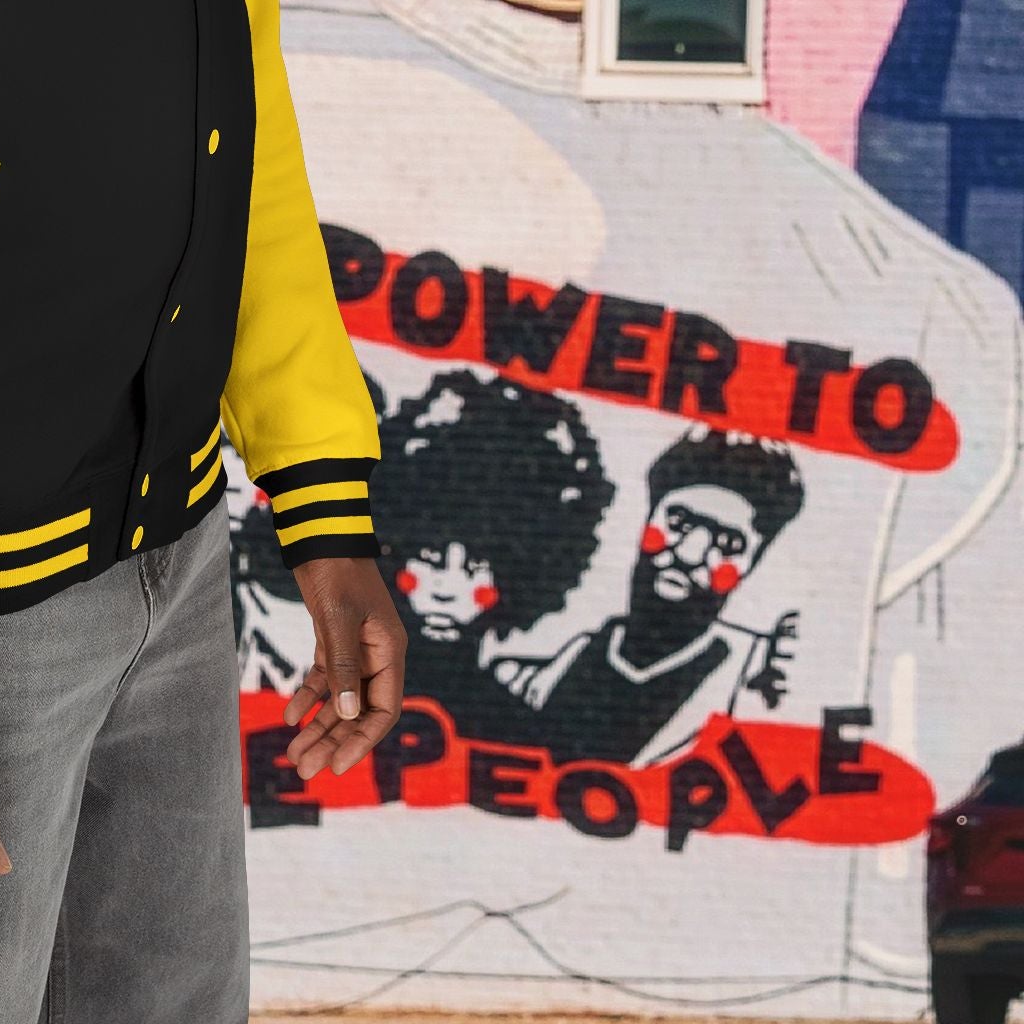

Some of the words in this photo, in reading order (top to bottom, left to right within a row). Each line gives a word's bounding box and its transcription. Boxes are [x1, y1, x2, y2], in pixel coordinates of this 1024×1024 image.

[319, 222, 737, 416] POWER
[786, 341, 937, 454] TO
[372, 707, 880, 852] PEOPLE
